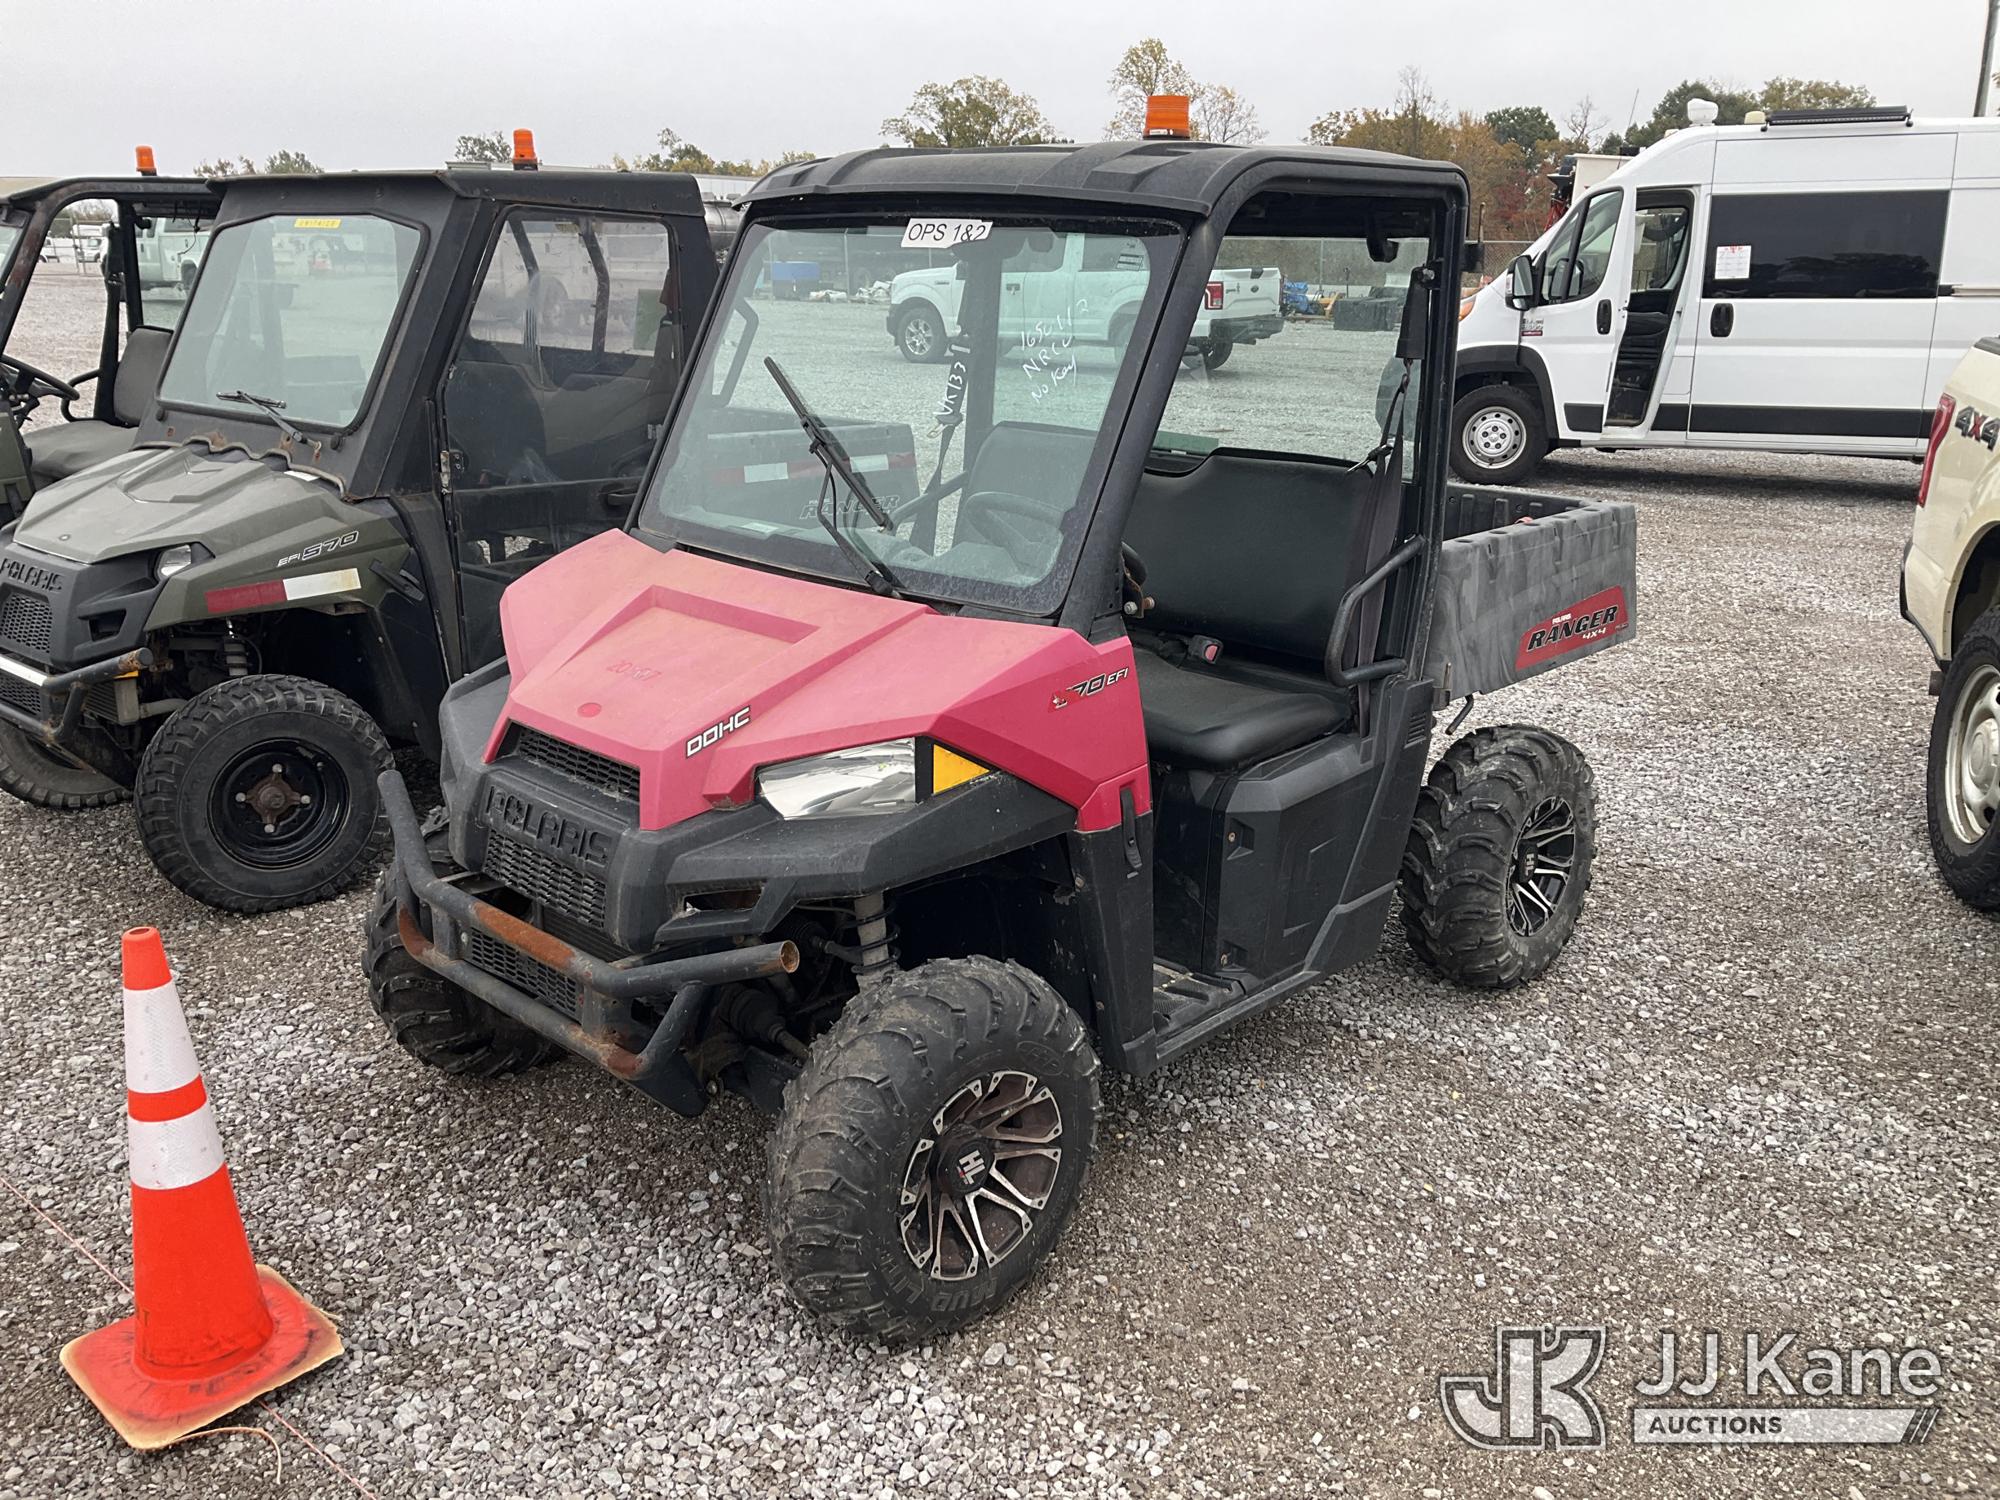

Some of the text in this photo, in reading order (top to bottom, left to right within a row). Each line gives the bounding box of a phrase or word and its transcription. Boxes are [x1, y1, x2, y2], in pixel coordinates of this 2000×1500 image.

[908, 223, 986, 242] OPS 1&2
[277, 530, 359, 567] EFI 570
[0, 558, 63, 592] POLARIS
[1526, 604, 1619, 652] RANGER
[1107, 667, 1129, 685] EFI
[686, 705, 750, 758] DOHC
[486, 785, 609, 868] POLARIS
